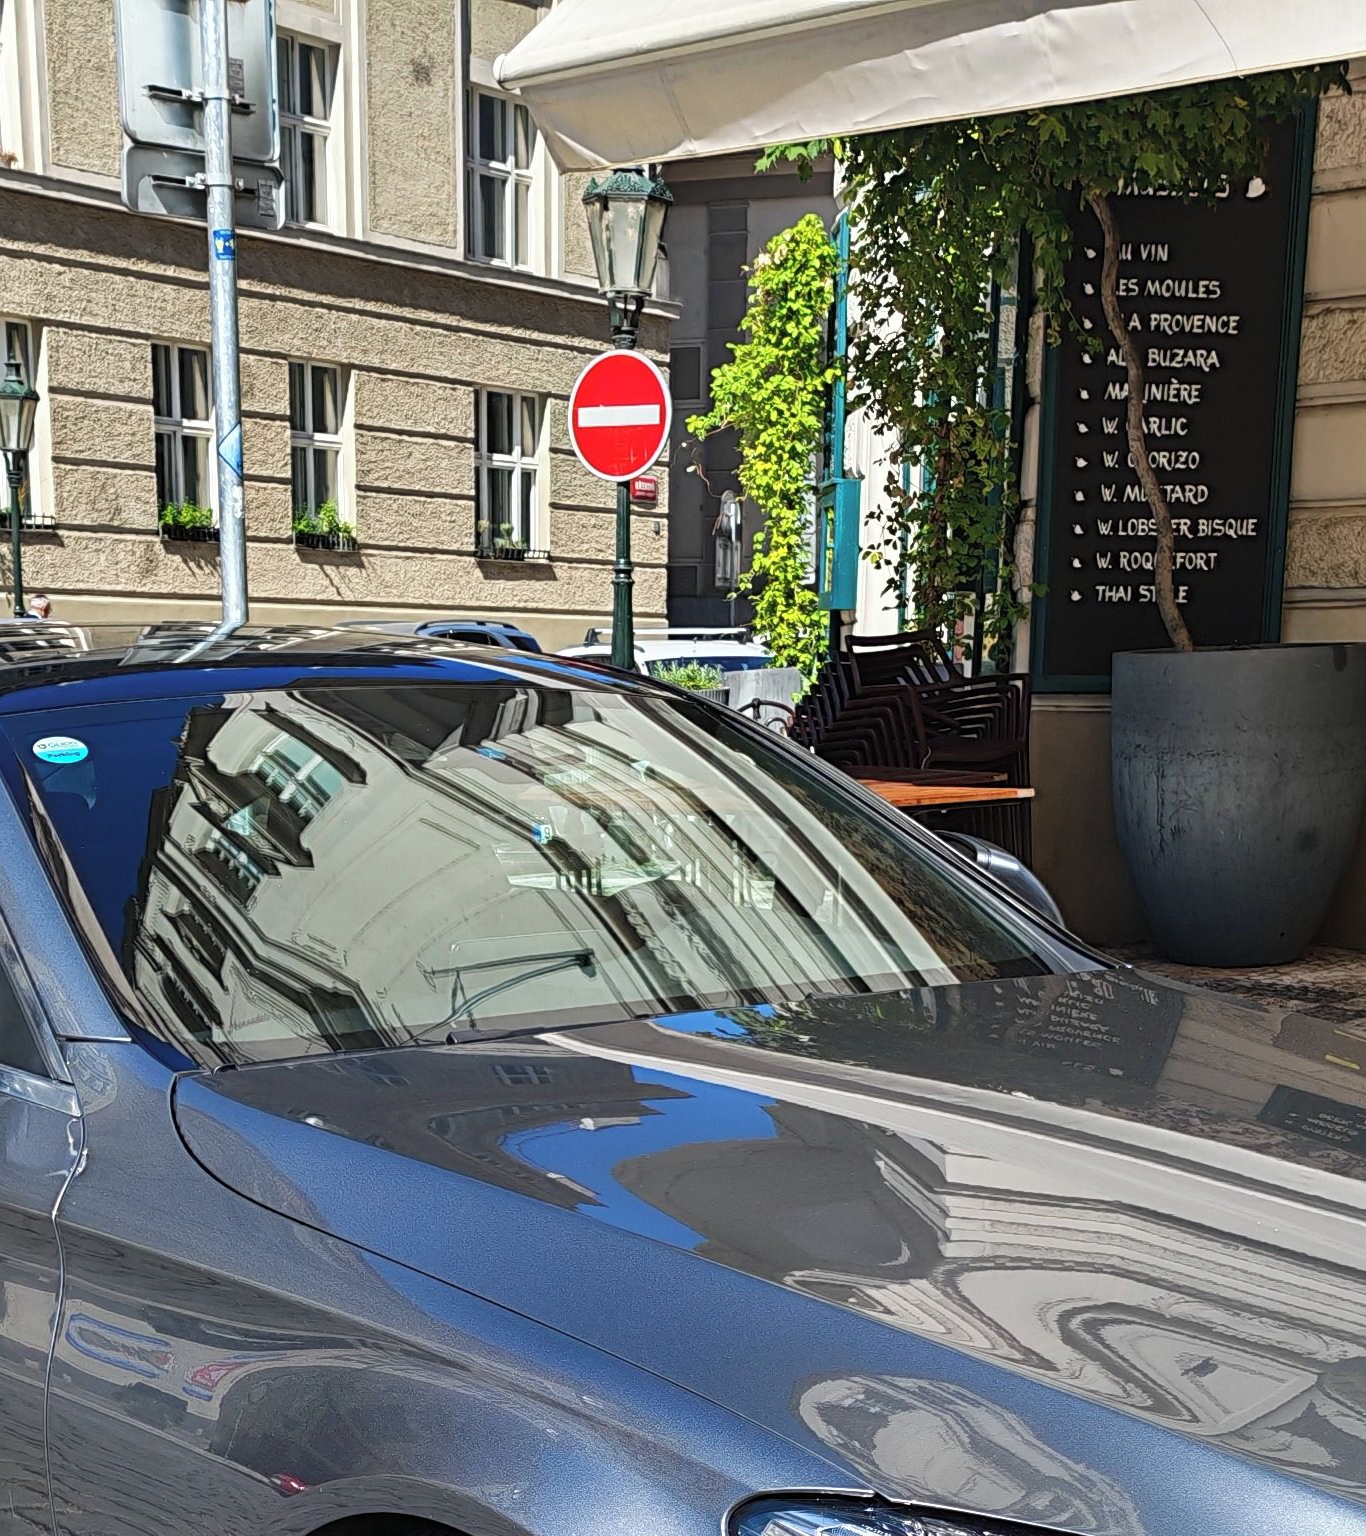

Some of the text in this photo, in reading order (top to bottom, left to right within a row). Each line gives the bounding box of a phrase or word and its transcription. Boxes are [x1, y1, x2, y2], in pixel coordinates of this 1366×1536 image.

[1140, 244, 1169, 261] VIN
[1116, 279, 1221, 298] ES MOULES
[1150, 314, 1240, 335] PROVENCE
[1147, 349, 1220, 372] BUZARA
[1104, 378, 1201, 404] MAINIÈRE
[1102, 417, 1118, 434] W.
[1103, 451, 1200, 471] W. CORIZO
[1101, 484, 1209, 504] W. MUTARD
[1097, 519, 1258, 538] W. LOBSER BISQUE
[1096, 552, 1217, 571] W. ROQFORT
[1096, 586, 1131, 602] THAI
